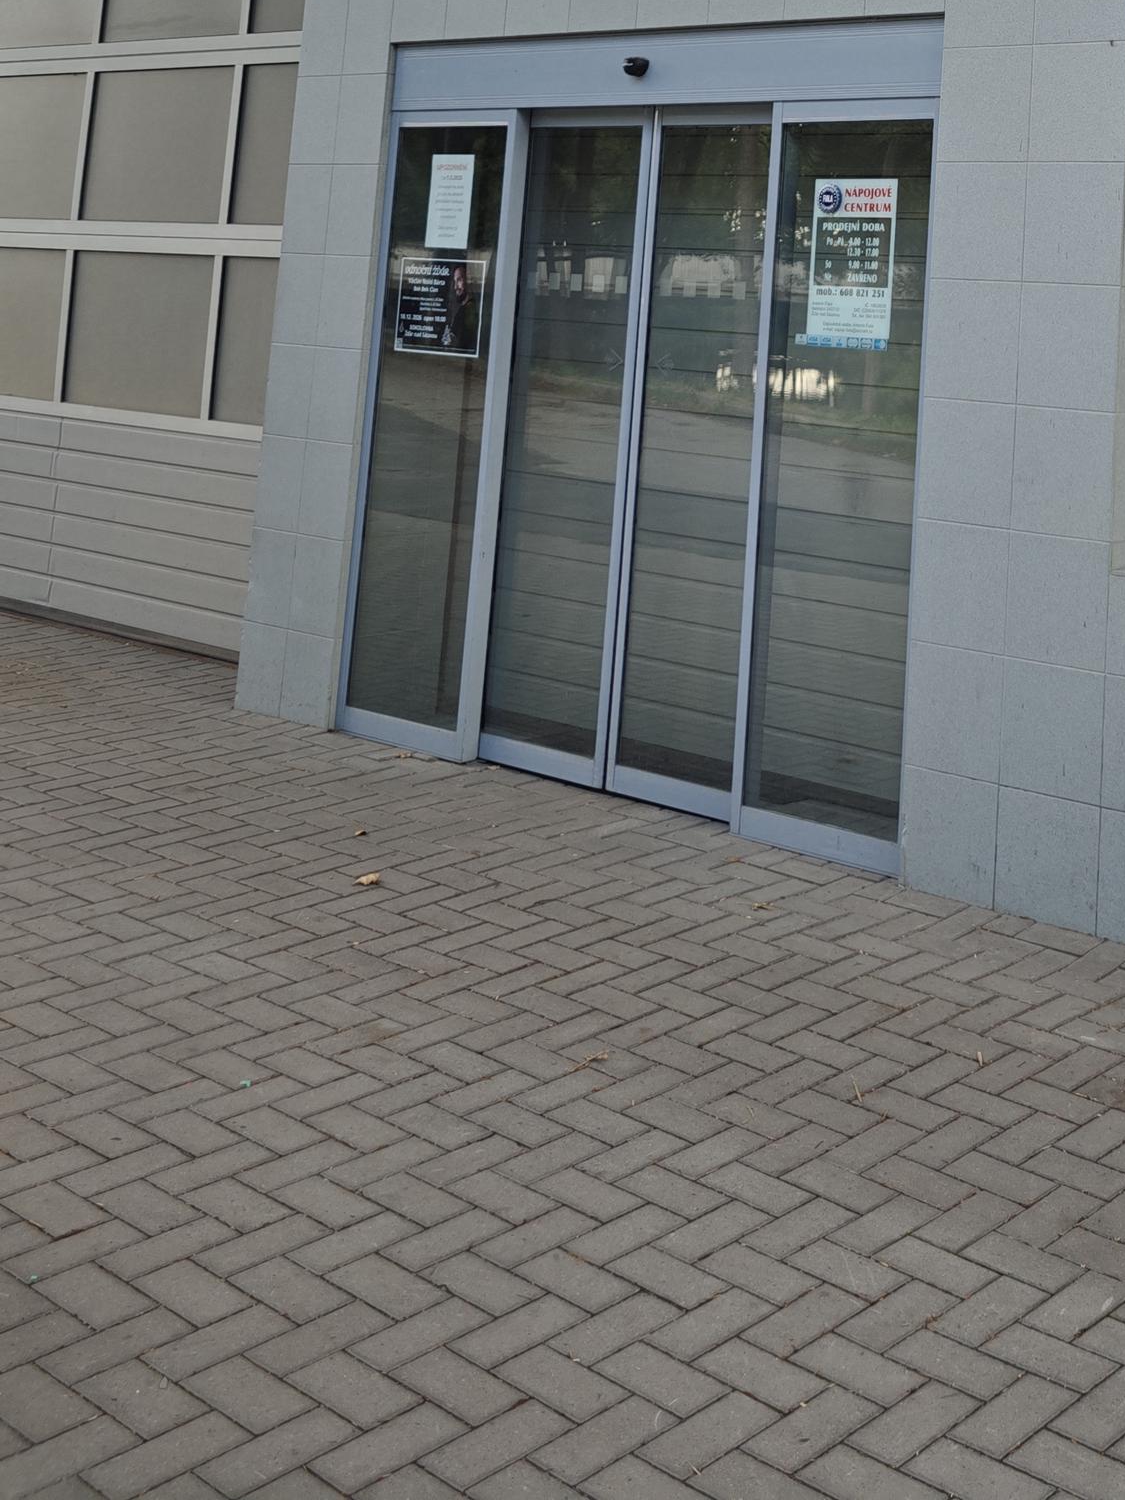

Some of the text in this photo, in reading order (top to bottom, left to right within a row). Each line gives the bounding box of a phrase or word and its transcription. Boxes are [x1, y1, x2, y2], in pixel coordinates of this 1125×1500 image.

[845, 186, 892, 199] NÁPOJOVÉ
[844, 203, 891, 212] CENTRUM
[823, 220, 885, 233] PRODEJNÍ DOBA
[847, 271, 878, 283] ZAVŘENO
[816, 288, 837, 296] mob.:
